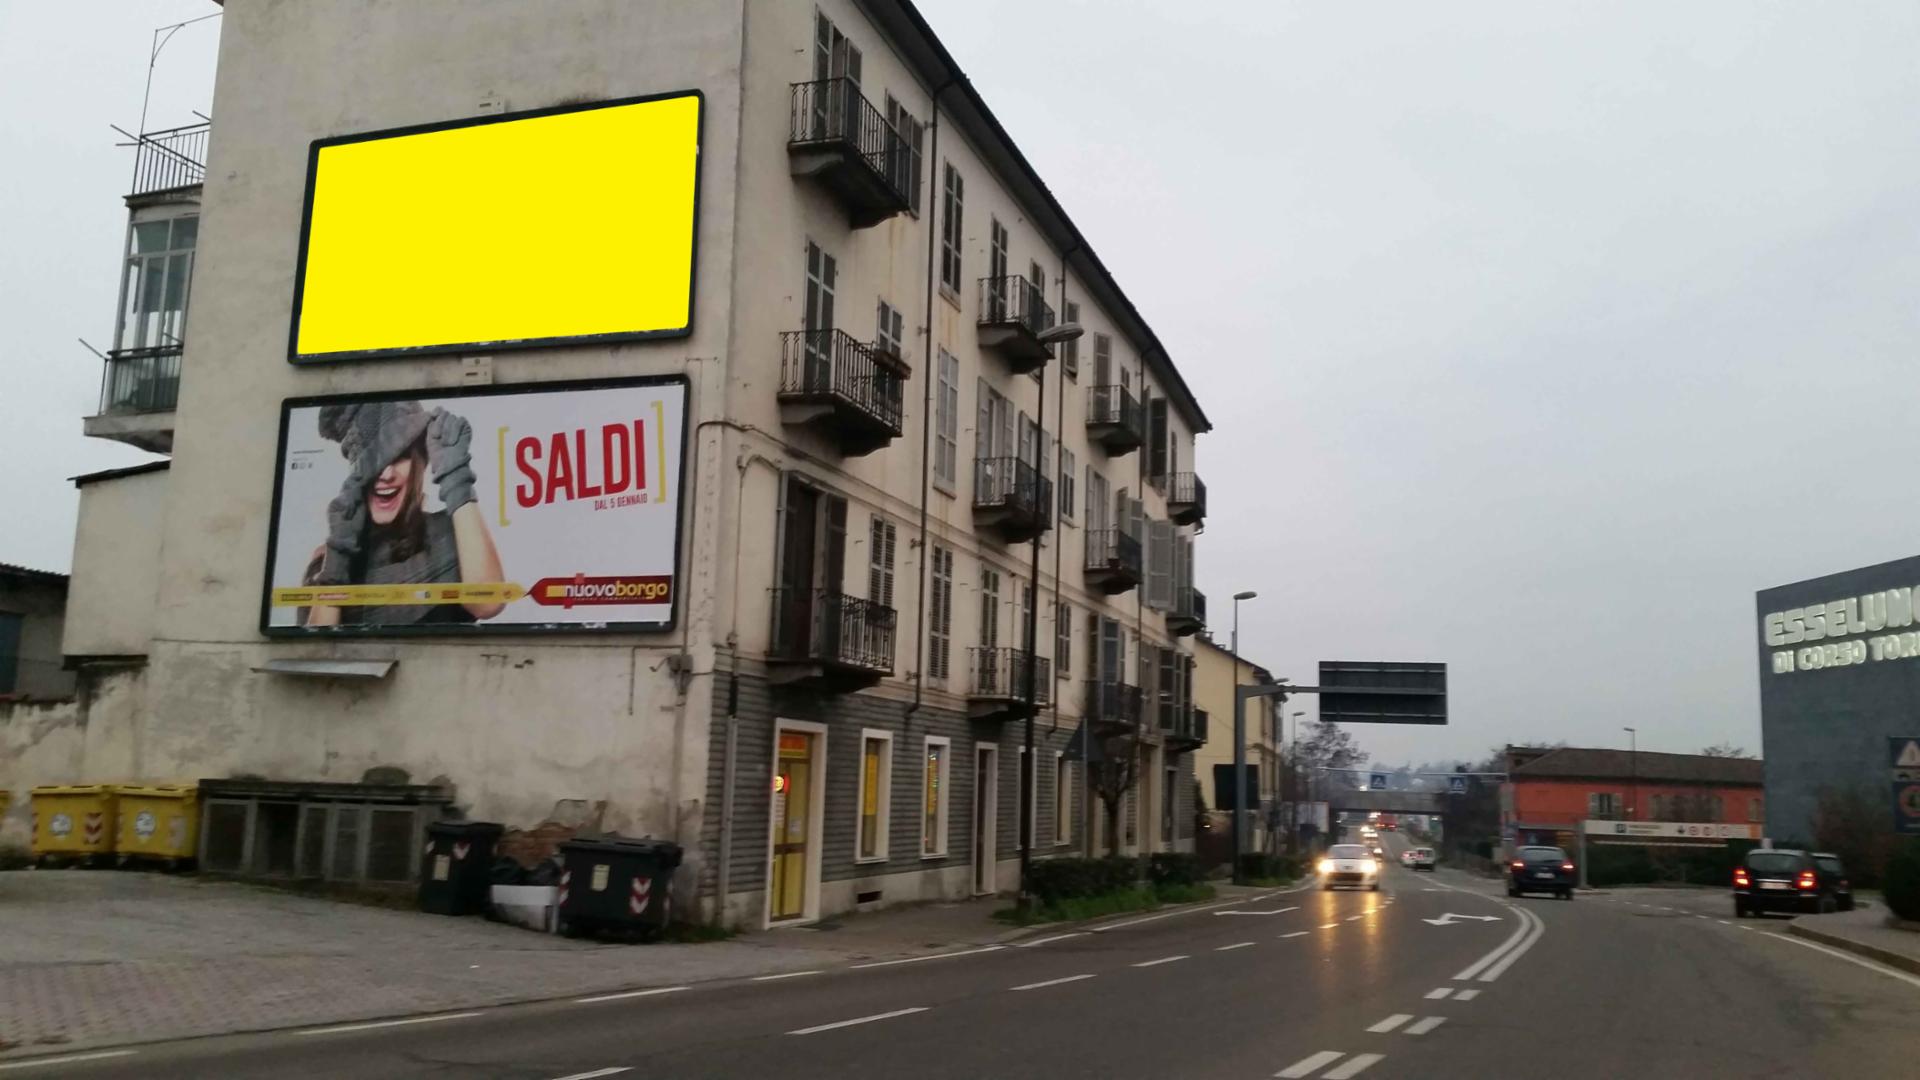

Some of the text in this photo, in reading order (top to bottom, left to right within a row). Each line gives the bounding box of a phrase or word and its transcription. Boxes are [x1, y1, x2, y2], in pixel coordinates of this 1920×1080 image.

[516, 419, 646, 508] SALDI
[565, 580, 667, 599] nuovoborgo
[1798, 640, 1866, 670] CORSO
